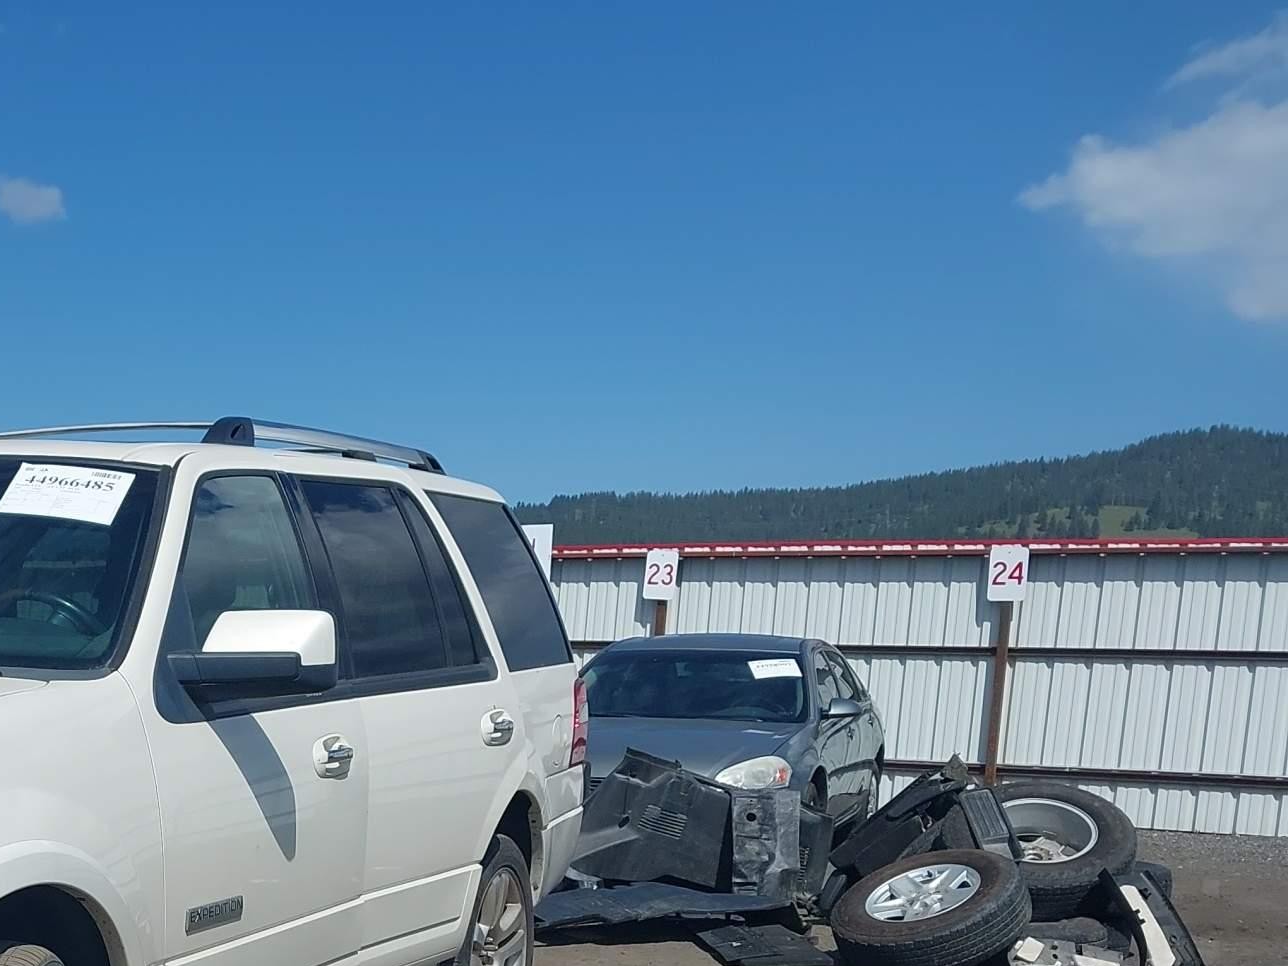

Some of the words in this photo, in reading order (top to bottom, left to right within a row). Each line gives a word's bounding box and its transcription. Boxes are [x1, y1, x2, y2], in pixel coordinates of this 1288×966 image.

[24, 475, 116, 492] 44966485
[647, 563, 674, 586] 23
[991, 561, 1024, 586] 24
[190, 896, 243, 923] EXPEDITION
